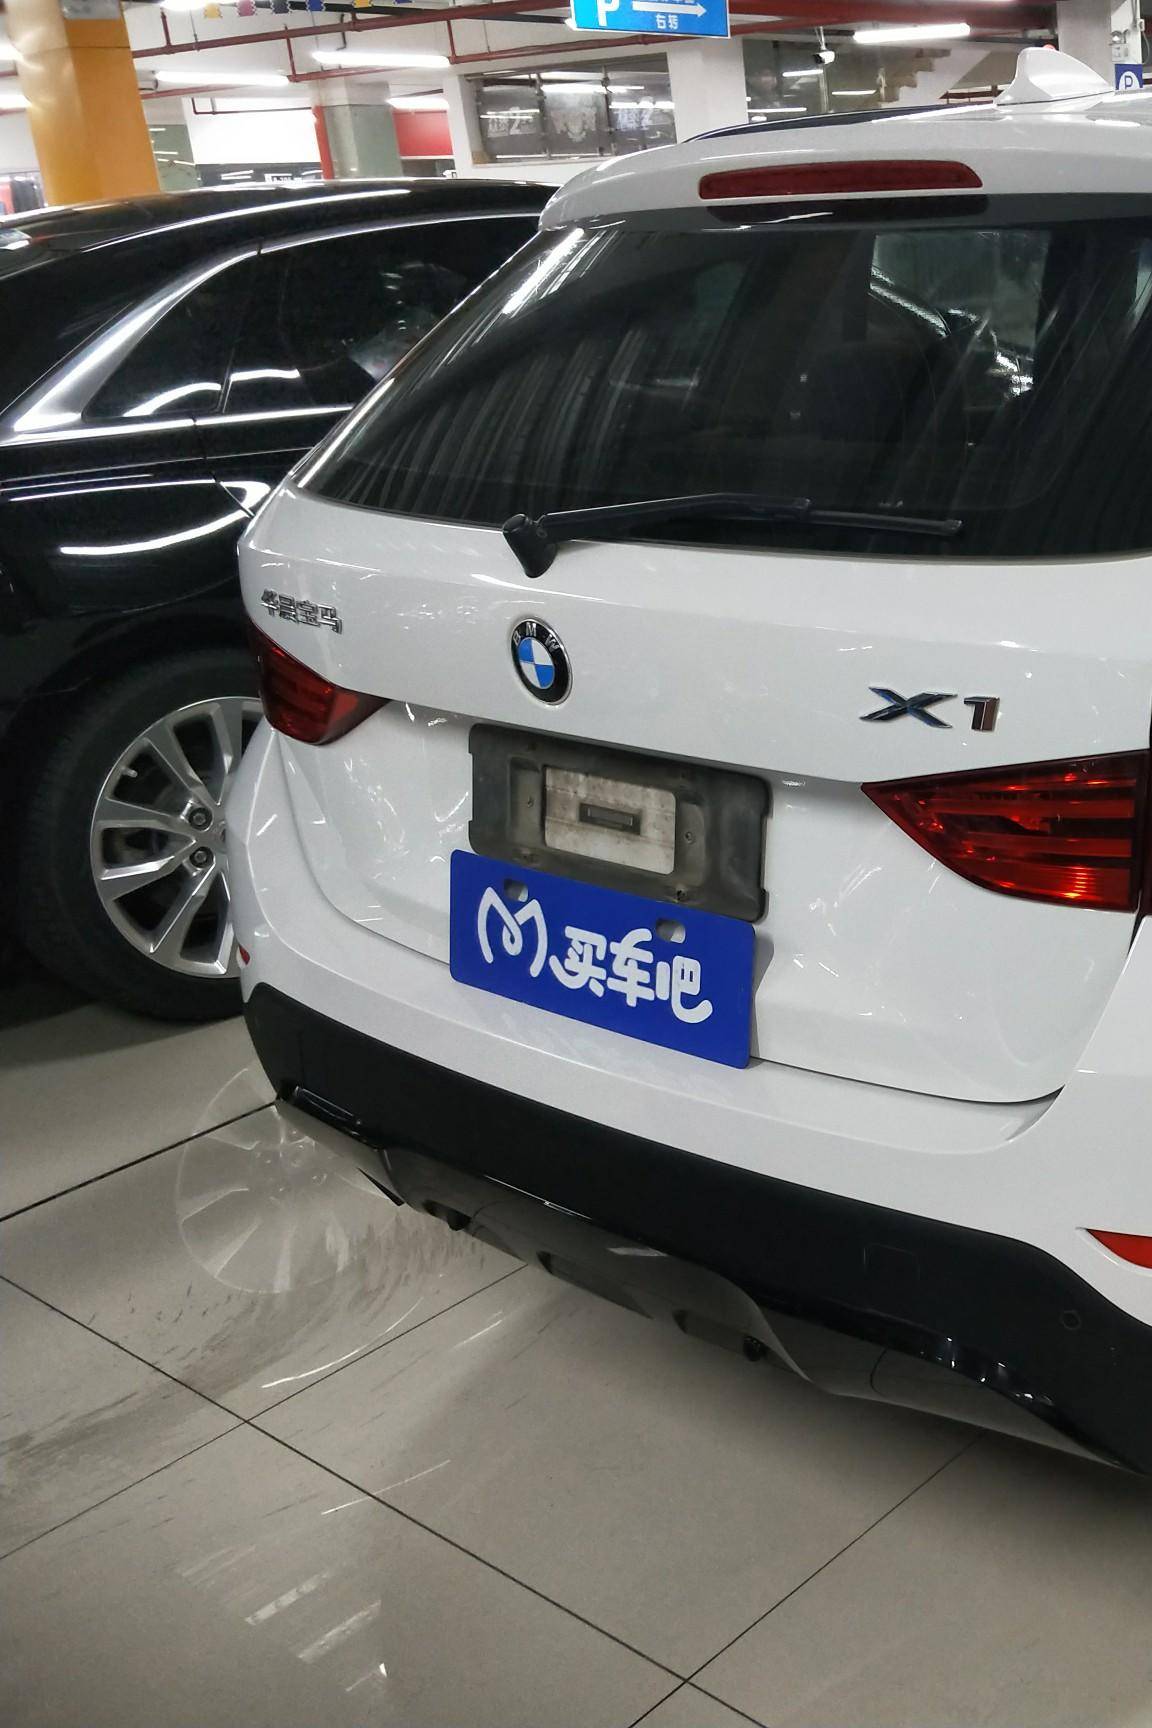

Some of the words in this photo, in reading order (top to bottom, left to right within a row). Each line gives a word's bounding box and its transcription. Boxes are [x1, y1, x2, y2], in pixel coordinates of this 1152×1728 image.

[655, 13, 679, 30] 右转
[1124, 75, 1133, 89] P
[512, 621, 560, 653] BMW
[859, 686, 1000, 731] X1
[549, 927, 713, 1024] 买车吧
